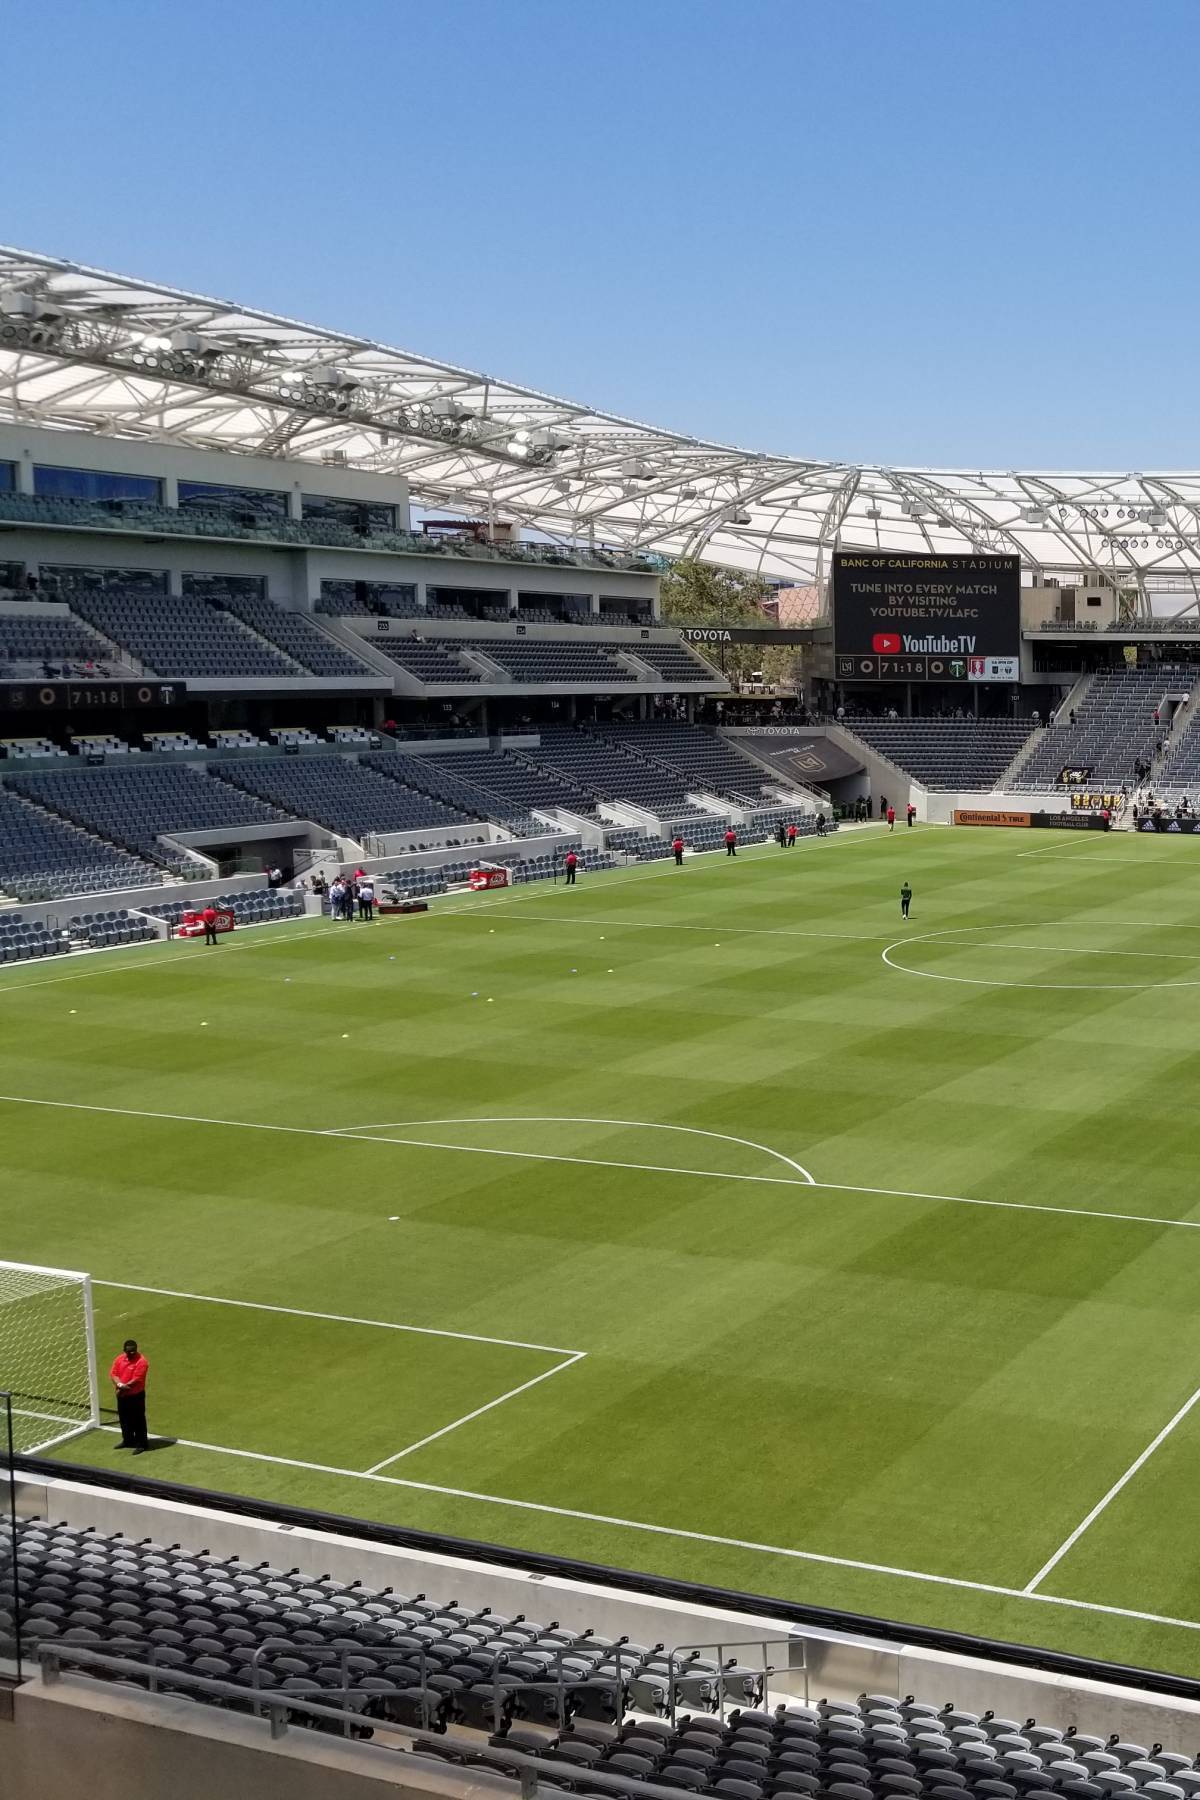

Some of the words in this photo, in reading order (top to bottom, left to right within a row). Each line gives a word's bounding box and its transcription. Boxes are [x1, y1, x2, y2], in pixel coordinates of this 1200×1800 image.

[840, 559, 869, 567] BANC
[872, 559, 885, 567] OF
[888, 560, 948, 569] CALIFORNIA
[952, 560, 1013, 569] STADIUM
[850, 583, 881, 593] TUNE
[884, 584, 912, 593] INTO
[916, 585, 952, 594] EVERY
[956, 585, 997, 595] MATCH
[889, 596, 902, 605] BY
[907, 596, 957, 606] VISITING
[870, 607, 979, 618] YOUTUBE.TV/LAFC
[687, 629, 732, 641] TOYOTA
[881, 662, 924, 673] 71:18
[73, 691, 119, 704] 71:18
[762, 727, 800, 735] TOYOTA
[960, 812, 1001, 822] Continental
